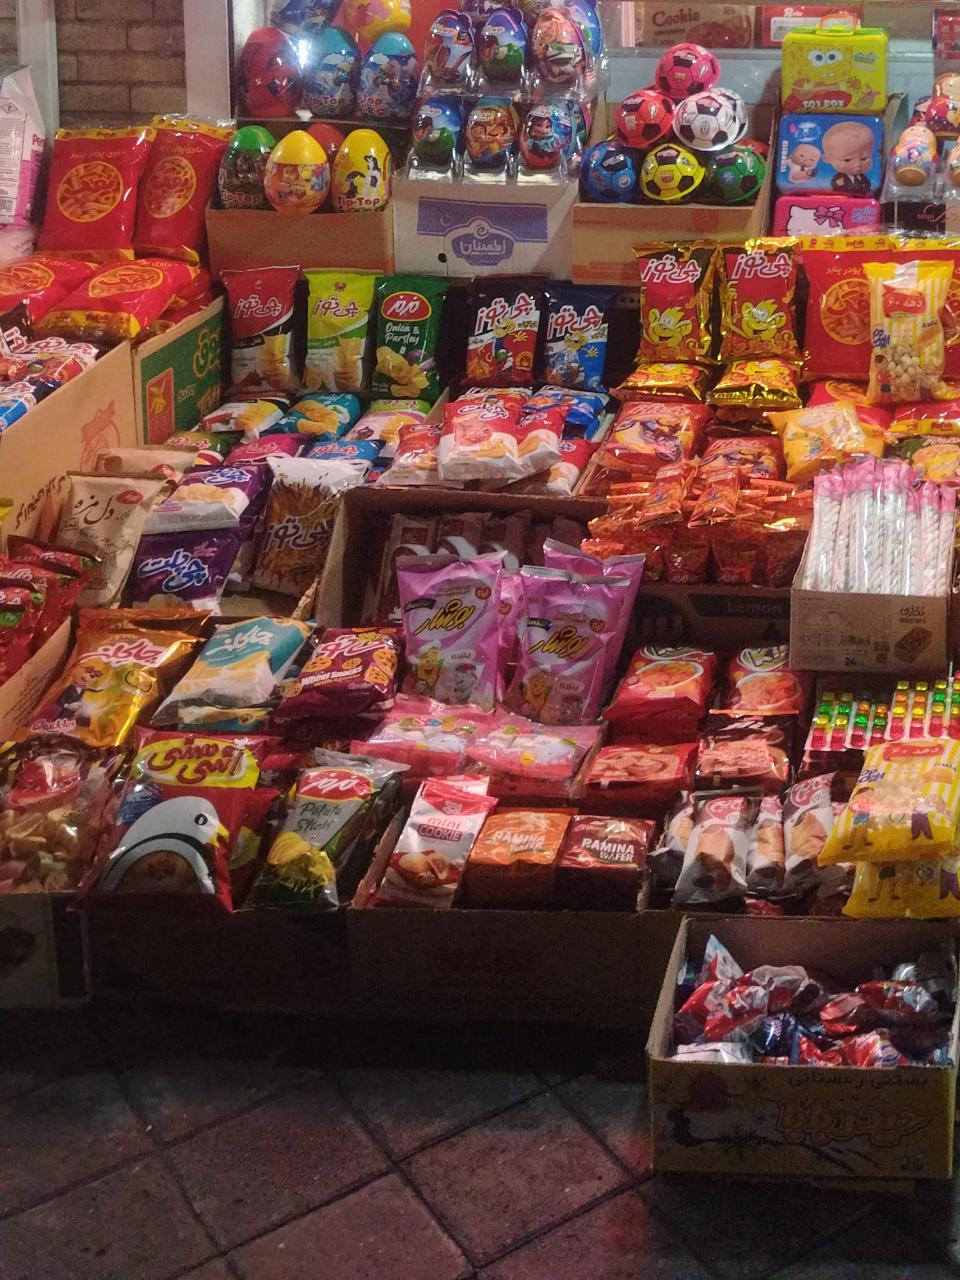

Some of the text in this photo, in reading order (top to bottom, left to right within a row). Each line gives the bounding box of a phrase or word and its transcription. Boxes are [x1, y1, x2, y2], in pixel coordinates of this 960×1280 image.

[652, 8, 701, 27] Cookie
[459, 239, 506, 256] اطمینان
[387, 294, 422, 316] مزمز
[385, 323, 410, 334] Onion
[385, 332, 420, 346] Parsley
[727, 600, 782, 615] Lemon
[299, 771, 358, 794] مزمز
[302, 803, 342, 817] Potato
[427, 816, 462, 830] mini
[418, 823, 462, 842] COOKIE
[581, 837, 635, 854] RAMINA
[599, 850, 634, 862] WAFER
